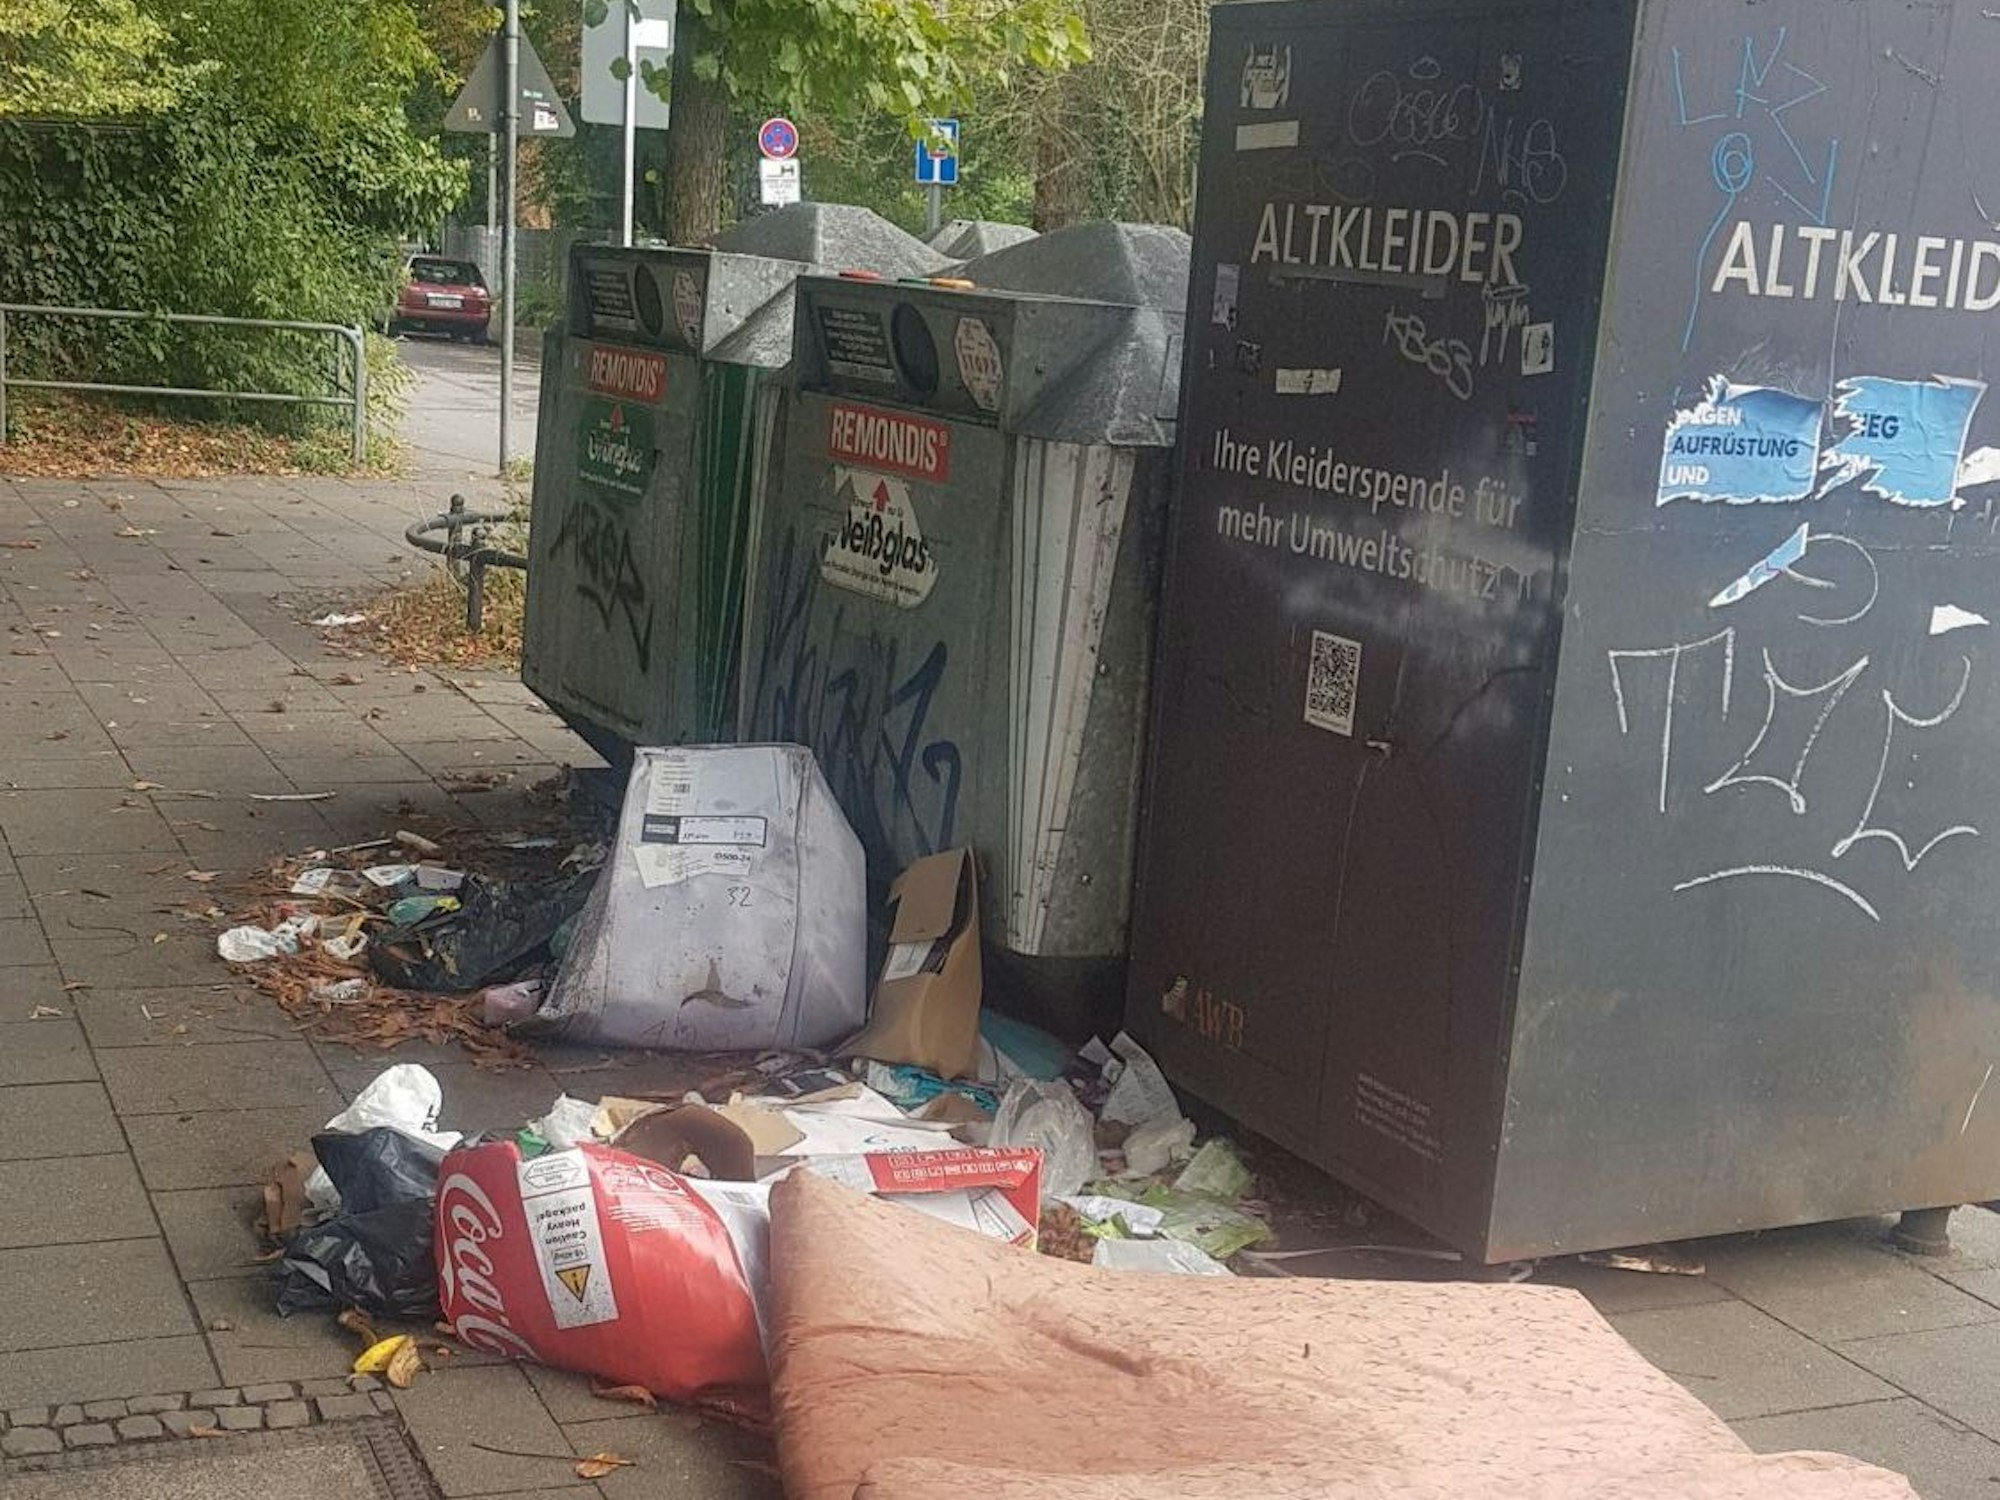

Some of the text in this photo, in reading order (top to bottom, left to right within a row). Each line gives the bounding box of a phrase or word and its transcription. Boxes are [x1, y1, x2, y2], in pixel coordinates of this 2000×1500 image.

[1251, 203, 1524, 286] ALTKLEIDER
[1711, 220, 2000, 311] ALTKLEID
[1672, 432, 1799, 458] AUFRÜSTUNG
[1213, 428, 1522, 529] Ihre Kleiderspende für
[1667, 466, 1709, 486] UND
[1217, 503, 1498, 601] mehr Umweltschutz
[545, 1231, 588, 1245] Caution
[547, 1218, 581, 1231] Heavy
